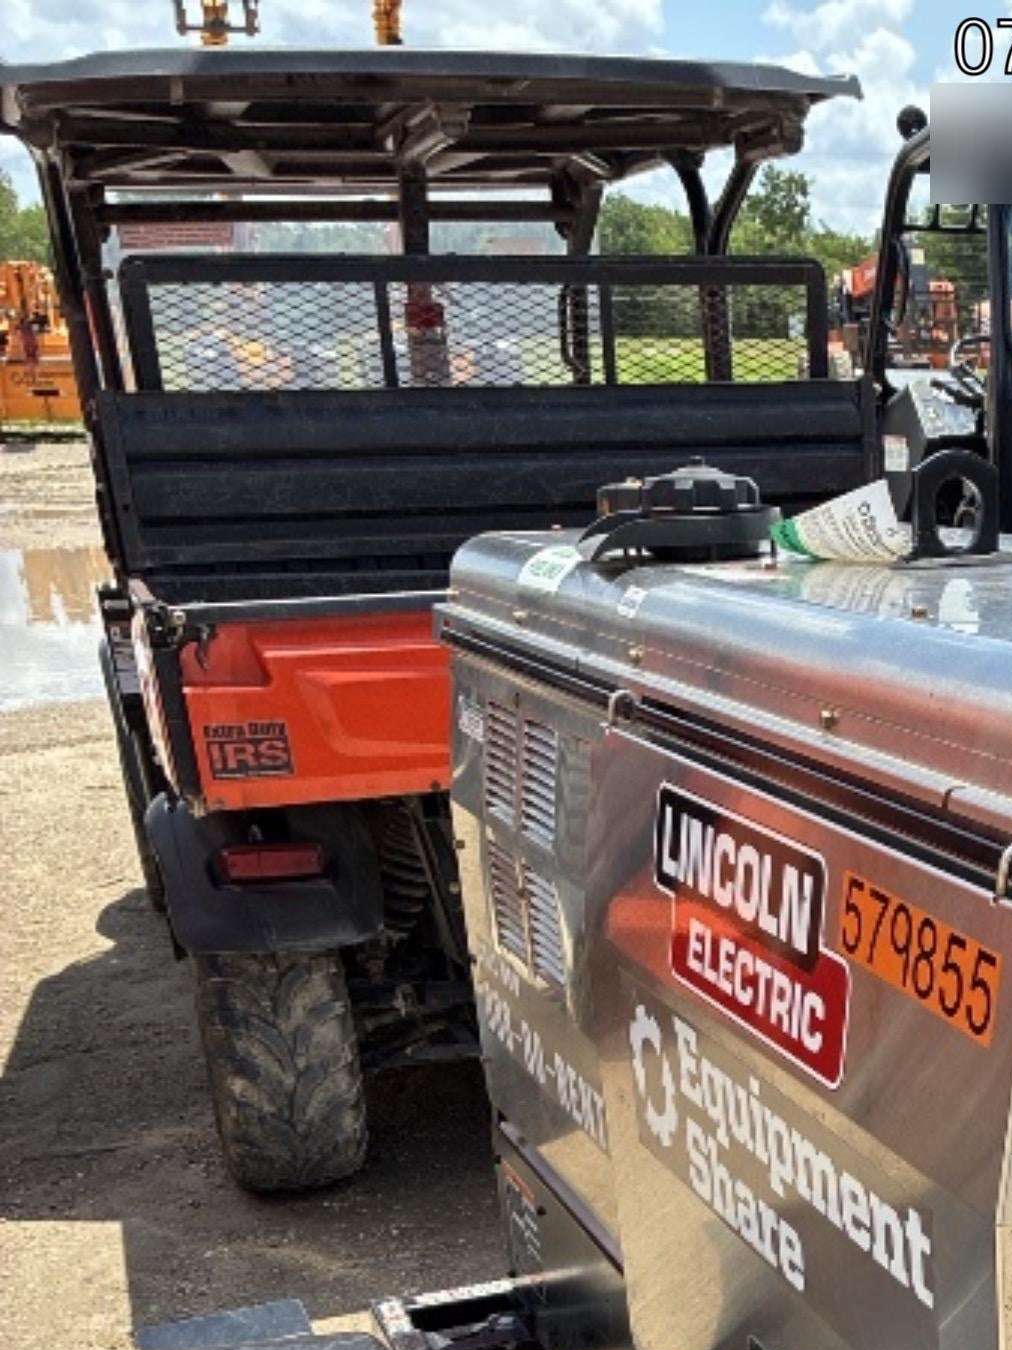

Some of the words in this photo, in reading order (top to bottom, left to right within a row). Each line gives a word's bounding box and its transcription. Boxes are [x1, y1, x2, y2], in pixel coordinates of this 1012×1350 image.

[210, 739, 289, 770] IRS
[661, 804, 814, 954] LINCOLN
[686, 917, 826, 1054] ELECTRIC
[840, 877, 998, 1036] 579855
[672, 1015, 934, 1309] Equipment
[685, 1117, 806, 1291] Share
